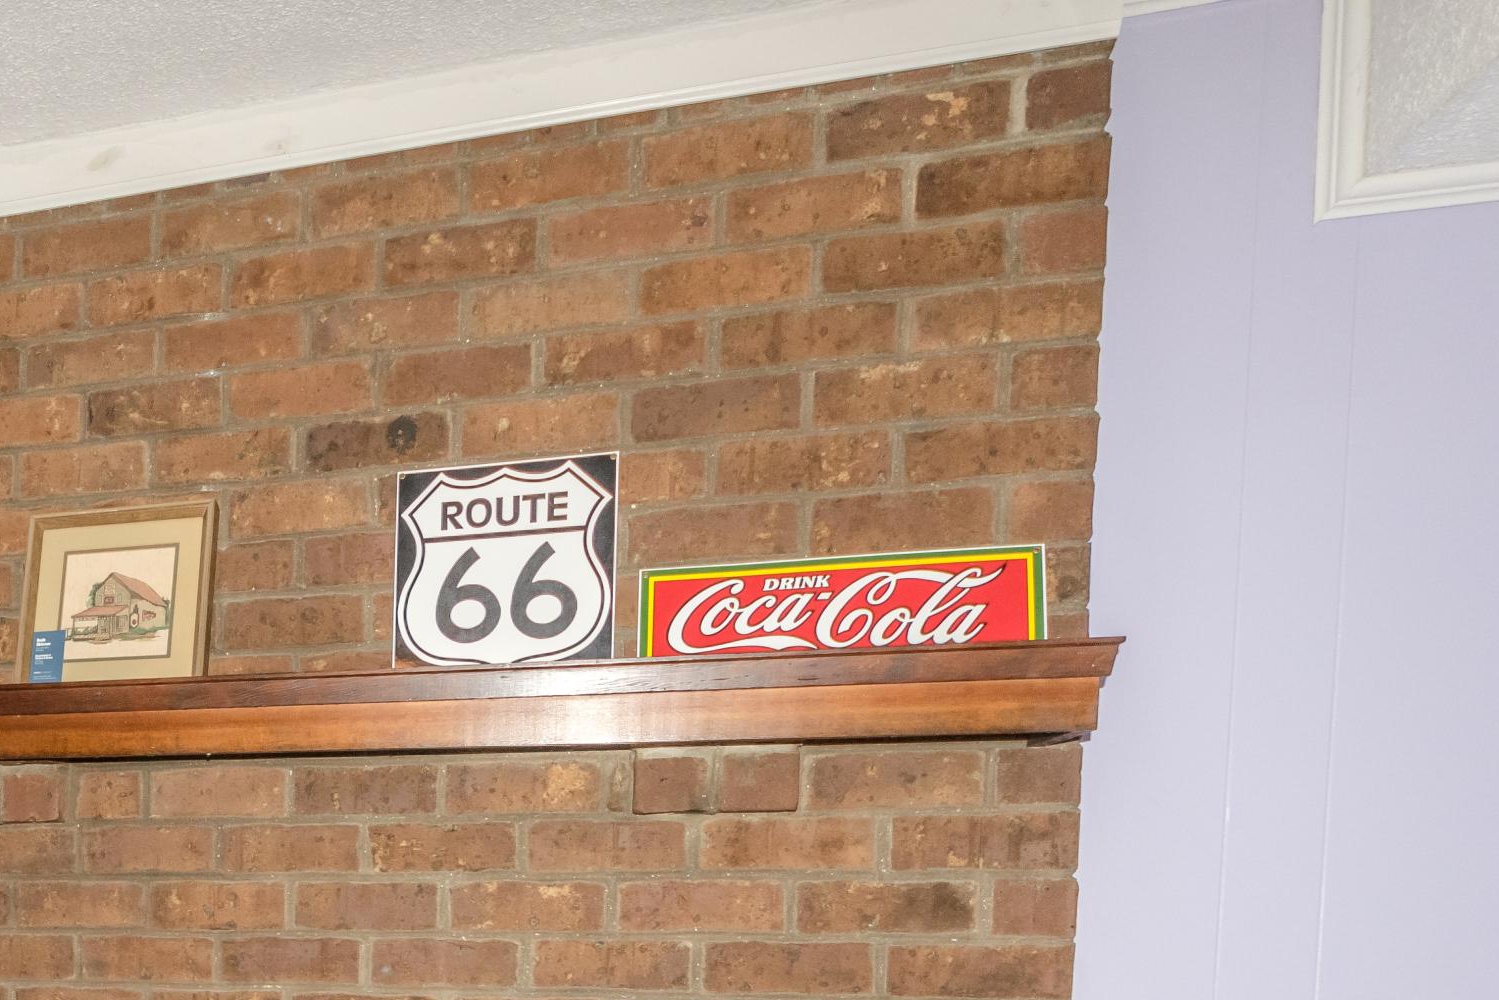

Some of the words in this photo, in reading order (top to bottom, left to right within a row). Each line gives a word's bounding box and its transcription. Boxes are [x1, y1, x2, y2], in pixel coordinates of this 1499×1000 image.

[440, 491, 568, 531] ROUTE
[435, 541, 577, 644] 66
[667, 564, 1006, 653] Coca-Cola
[762, 574, 832, 592] DRINK
